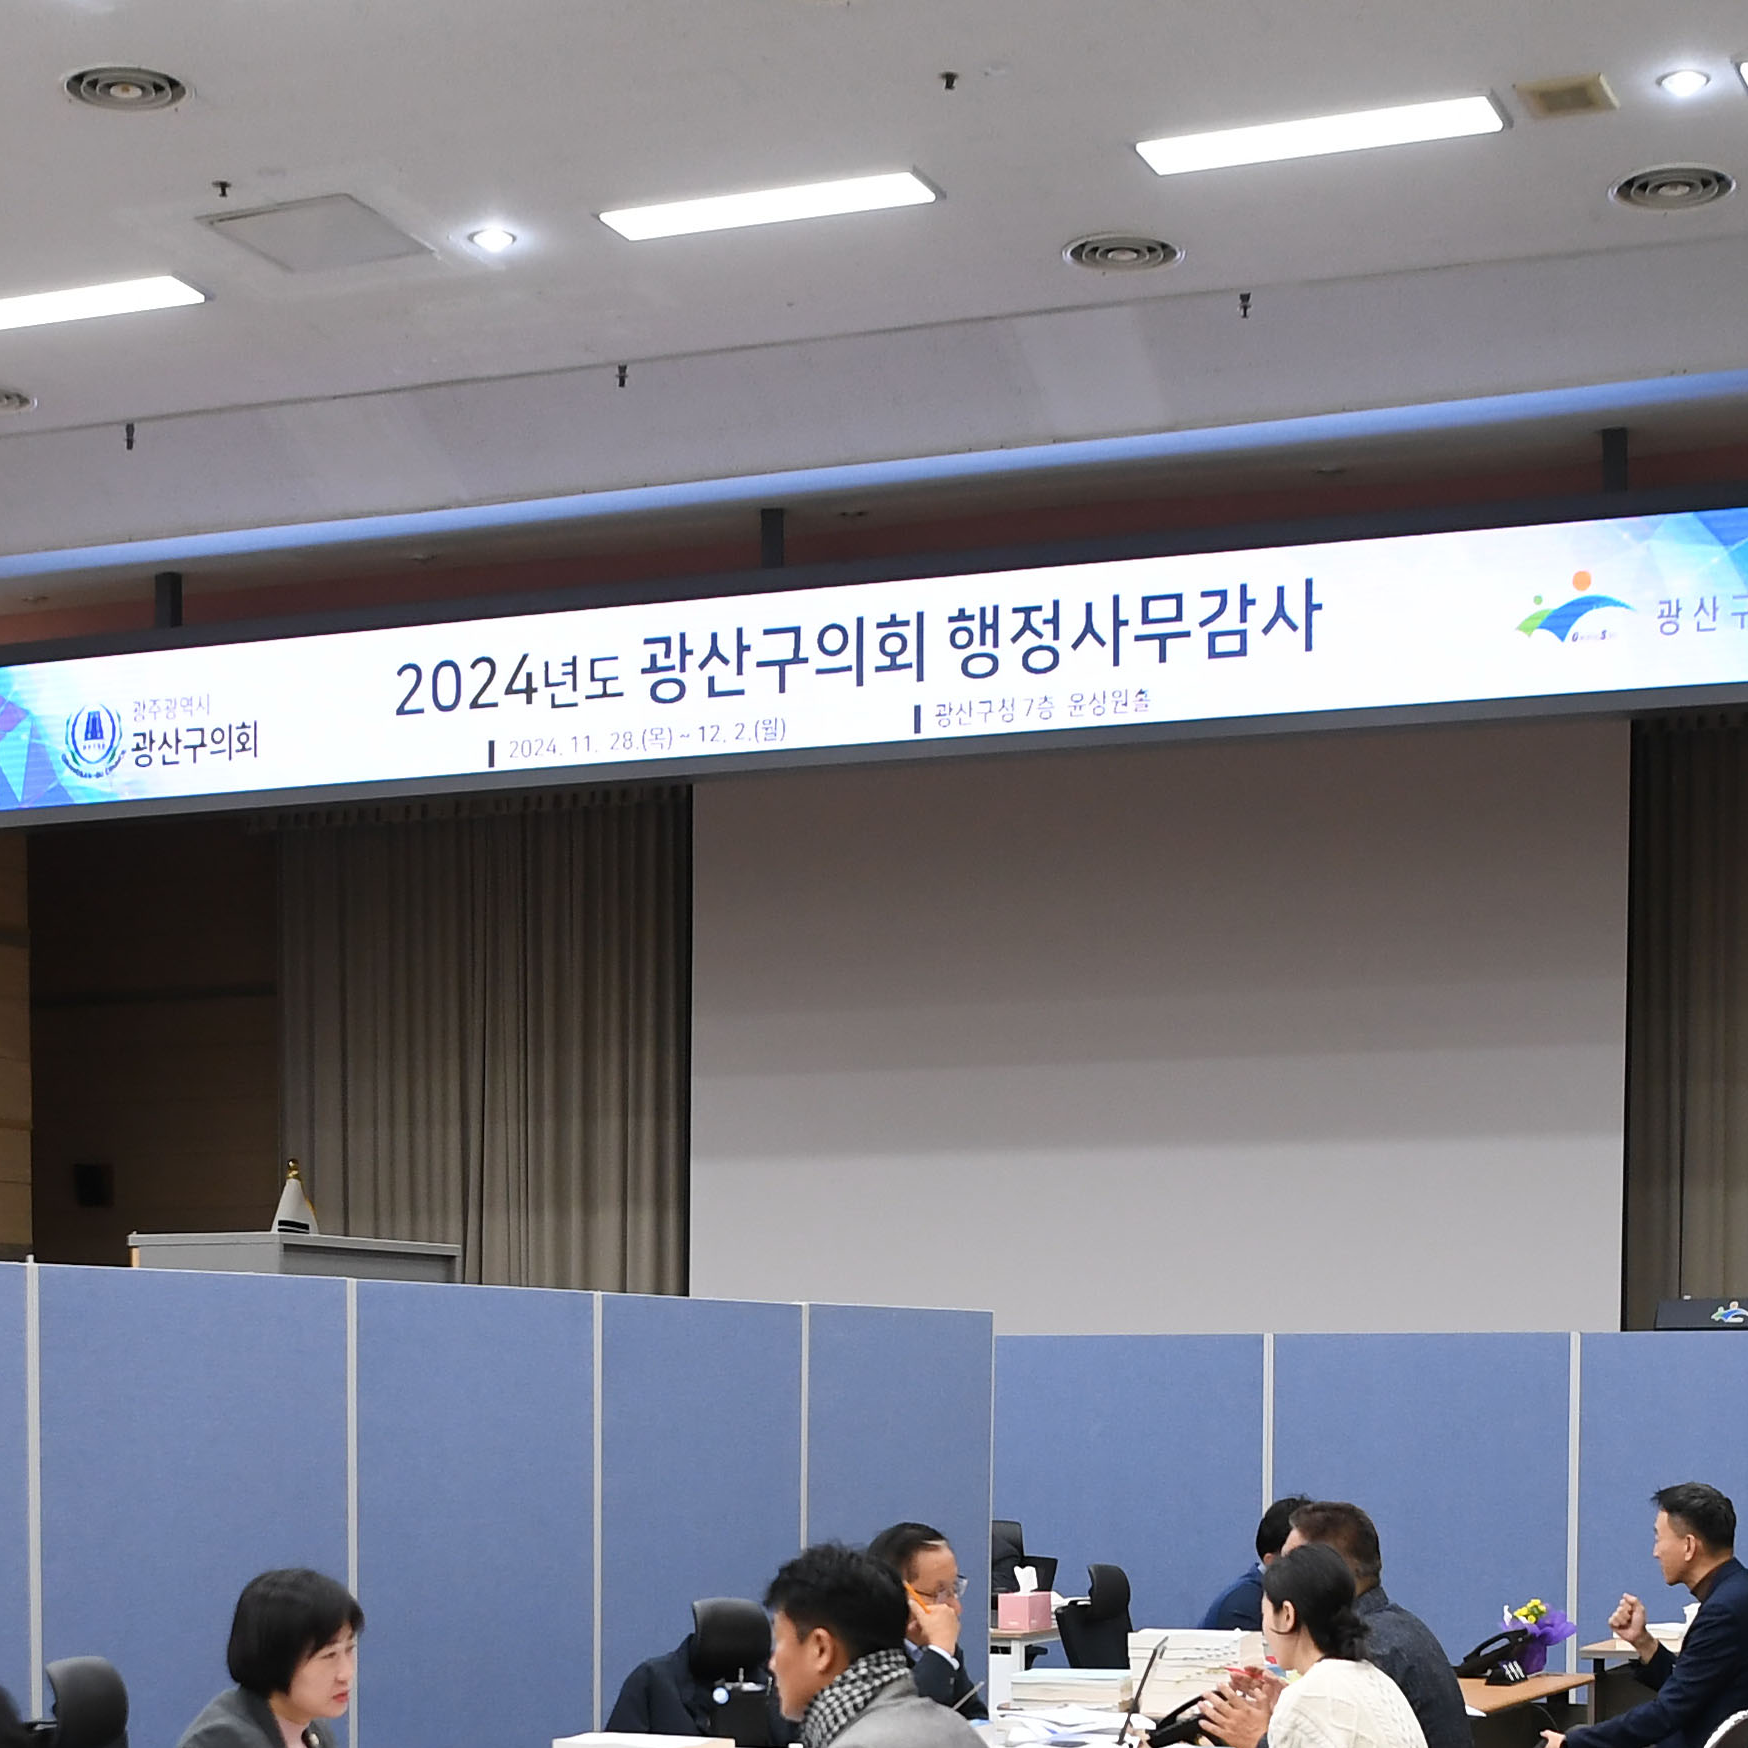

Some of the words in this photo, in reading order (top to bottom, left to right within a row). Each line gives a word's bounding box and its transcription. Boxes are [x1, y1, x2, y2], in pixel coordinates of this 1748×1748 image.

[395, 652, 625, 716] 2024년도
[640, 610, 925, 704] 광산구의회
[947, 576, 1323, 679] 행정사무감사
[132, 693, 211, 723] 광주광역시
[131, 719, 258, 768] 광산구의회
[508, 737, 564, 760] 2024.
[571, 735, 599, 754] 11.
[698, 723, 727, 744] 12.
